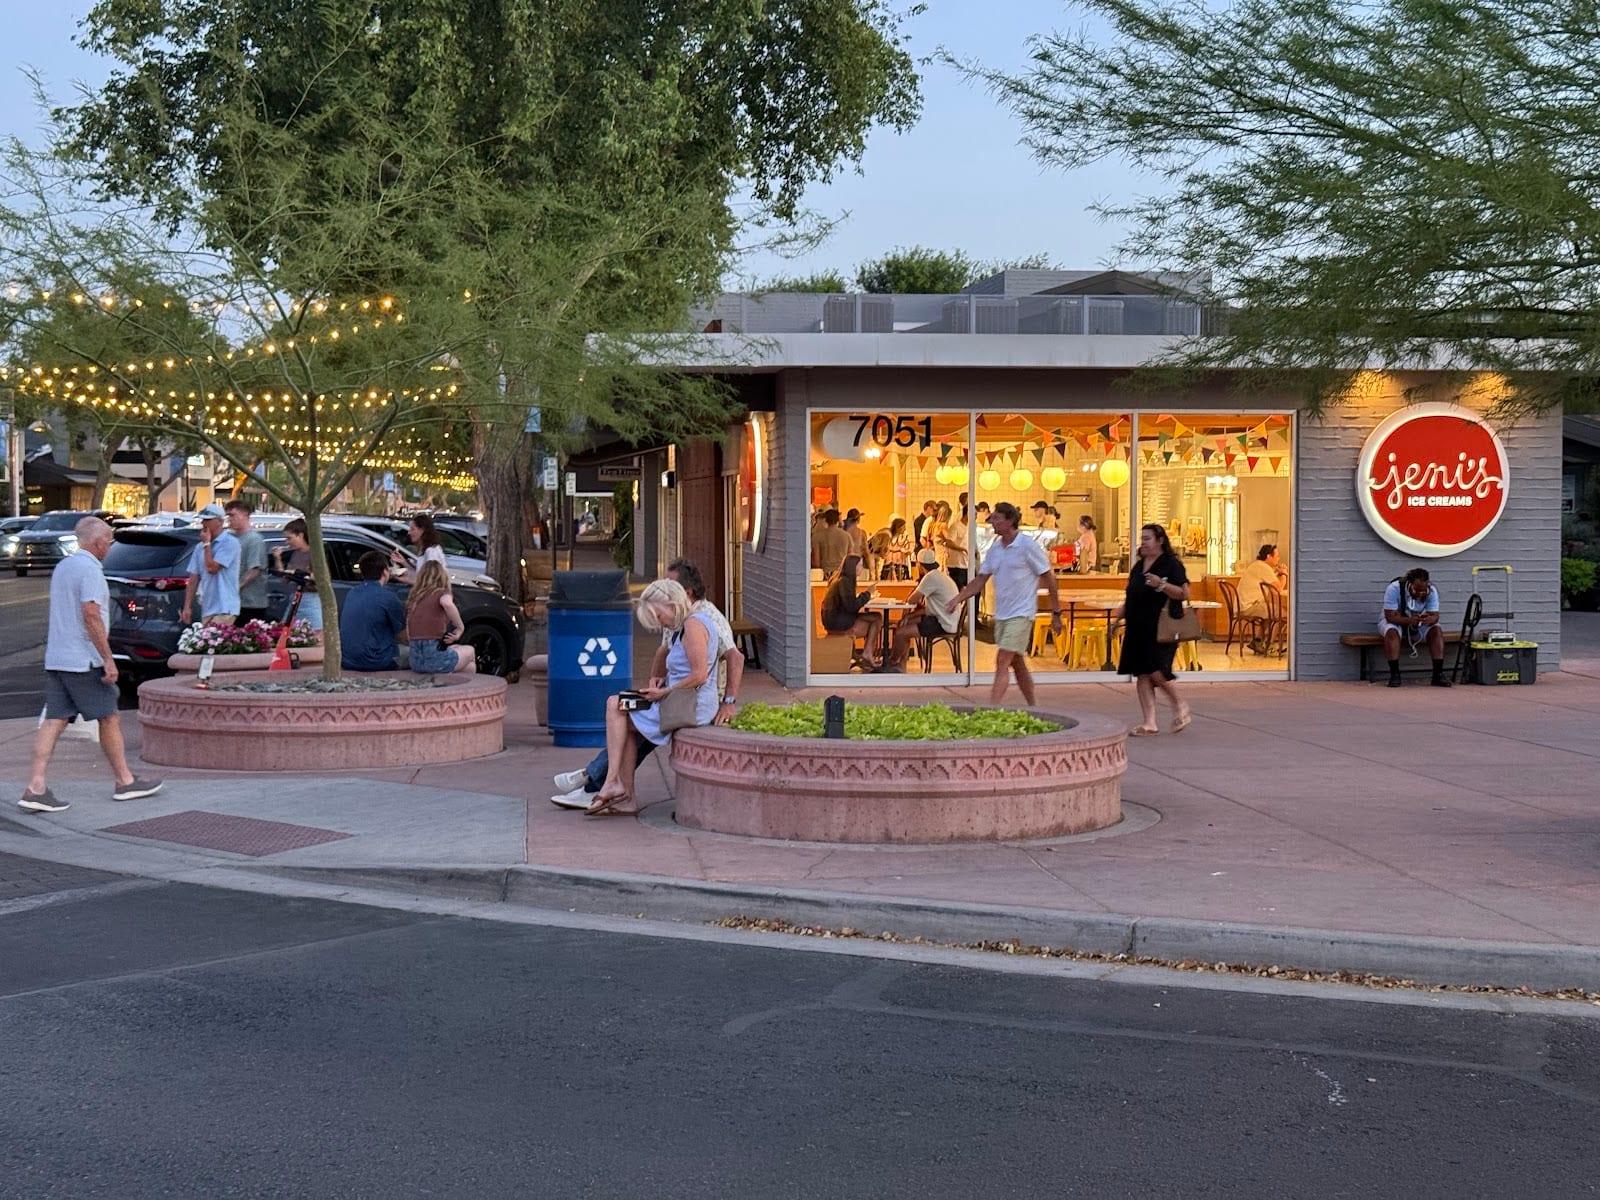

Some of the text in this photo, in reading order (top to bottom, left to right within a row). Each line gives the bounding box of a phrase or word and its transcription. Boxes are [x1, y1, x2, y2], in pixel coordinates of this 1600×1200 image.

[848, 415, 932, 448] 7051
[1369, 451, 1503, 509] jeni's
[1407, 496, 1472, 506] ICE CREAMS
